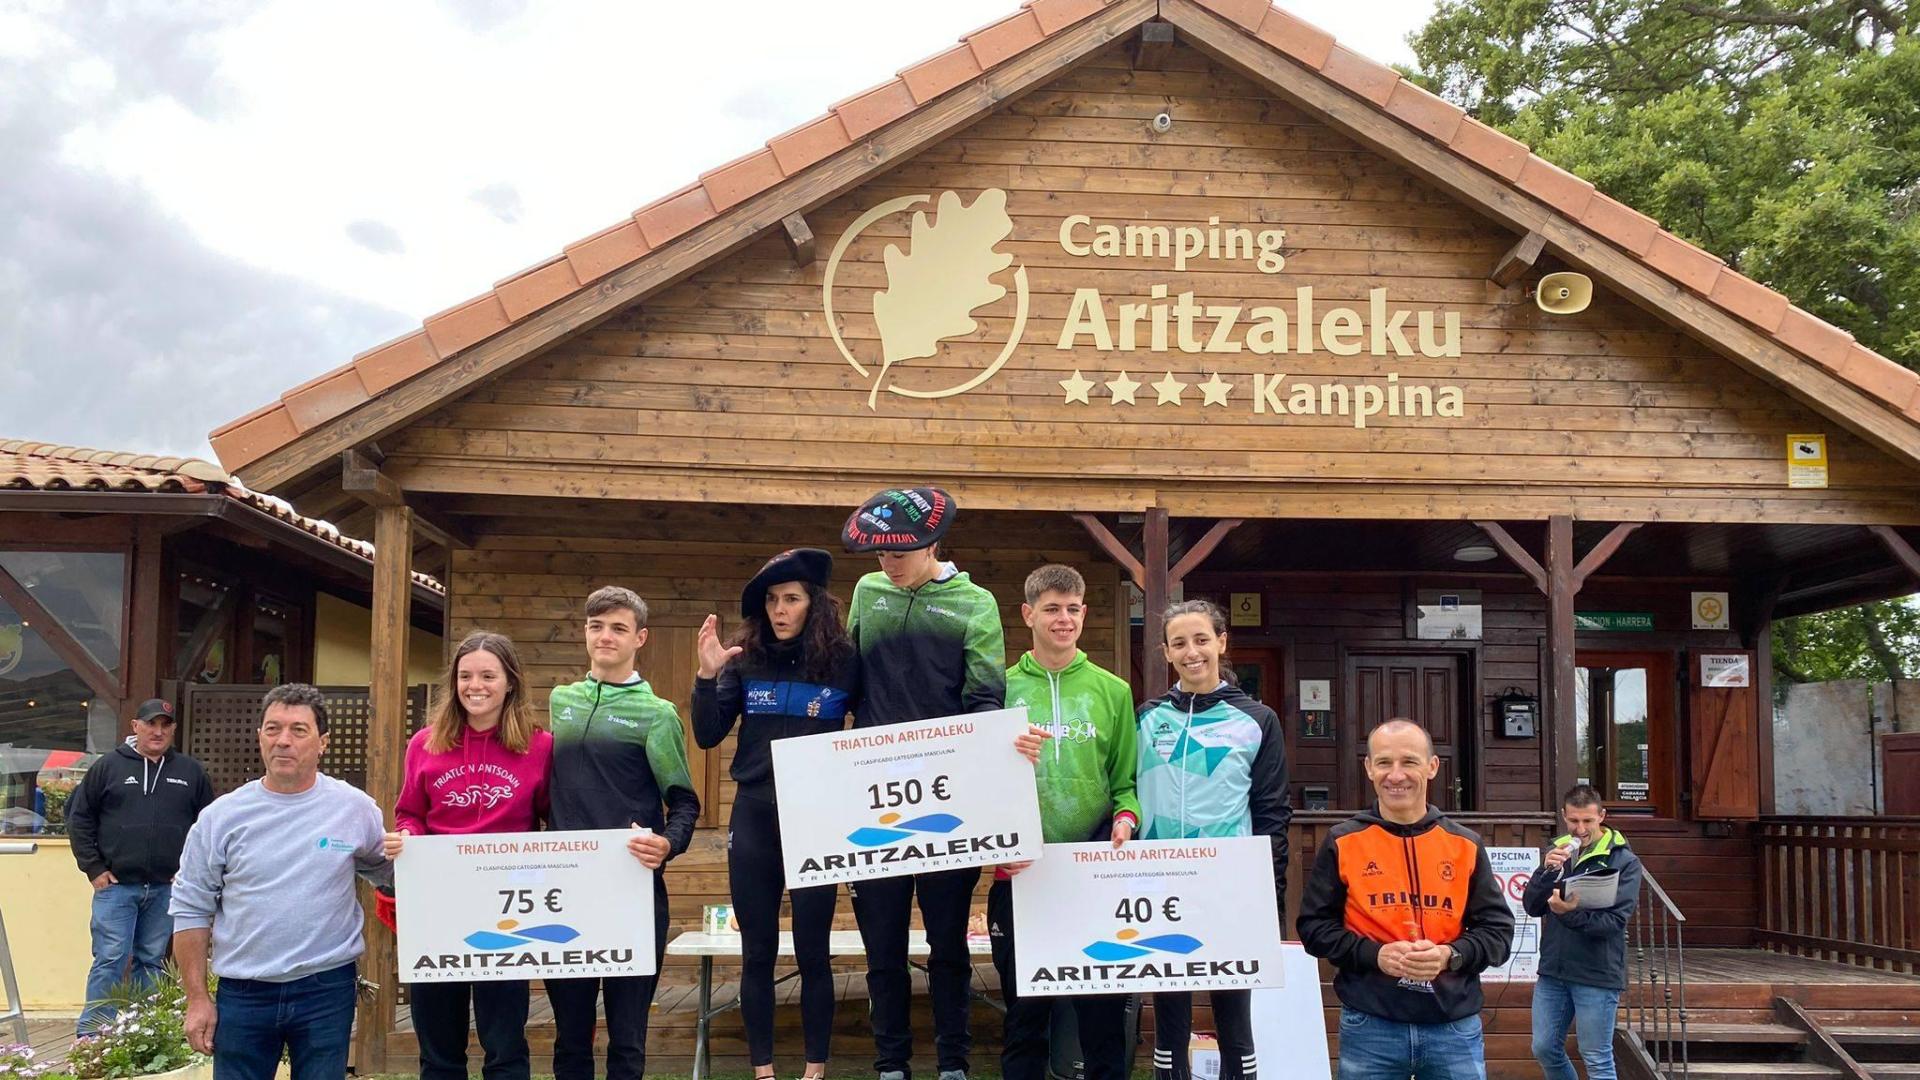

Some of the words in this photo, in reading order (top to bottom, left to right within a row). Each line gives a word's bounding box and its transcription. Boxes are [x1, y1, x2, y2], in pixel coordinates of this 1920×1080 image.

[1058, 213, 1286, 274] Camping
[1056, 283, 1462, 359] Aritzaleku
[1252, 372, 1464, 428] Kanpina
[1616, 616, 1652, 627] HARRERA
[832, 733, 894, 751] TRIATLON
[898, 722, 974, 742] ARITZALEKU
[860, 756, 894, 766] CLASIFICADO
[924, 748, 955, 757] MASCULINA
[433, 764, 475, 789] TRIATLON
[478, 763, 520, 788] ANTSOAIN
[867, 778, 922, 809] 150
[931, 775, 951, 801] €
[456, 843, 519, 855] TRIATLON
[522, 841, 599, 852] ARITZALEKU
[798, 832, 1019, 874] ARITZALEKU
[1073, 850, 1136, 863] TRIATLON
[1139, 847, 1217, 860] ARITZALEKU
[1491, 852, 1531, 861] PISCINA
[800, 866, 889, 882] TRIATLON
[921, 850, 1021, 868] TRIATLOIA
[498, 888, 535, 914] 75
[544, 888, 562, 914] €
[1114, 897, 1152, 923] 40
[1162, 896, 1181, 922] €
[1368, 891, 1453, 910] TRIKUA
[413, 949, 633, 969] ARITZALEKU
[1031, 959, 1260, 982] ARITZALEKU
[413, 971, 503, 979] TRIATLON
[535, 966, 634, 974] TRIATLOIA
[1031, 983, 1125, 992] TRIATLON
[1158, 978, 1262, 988] TRIATLOIA
